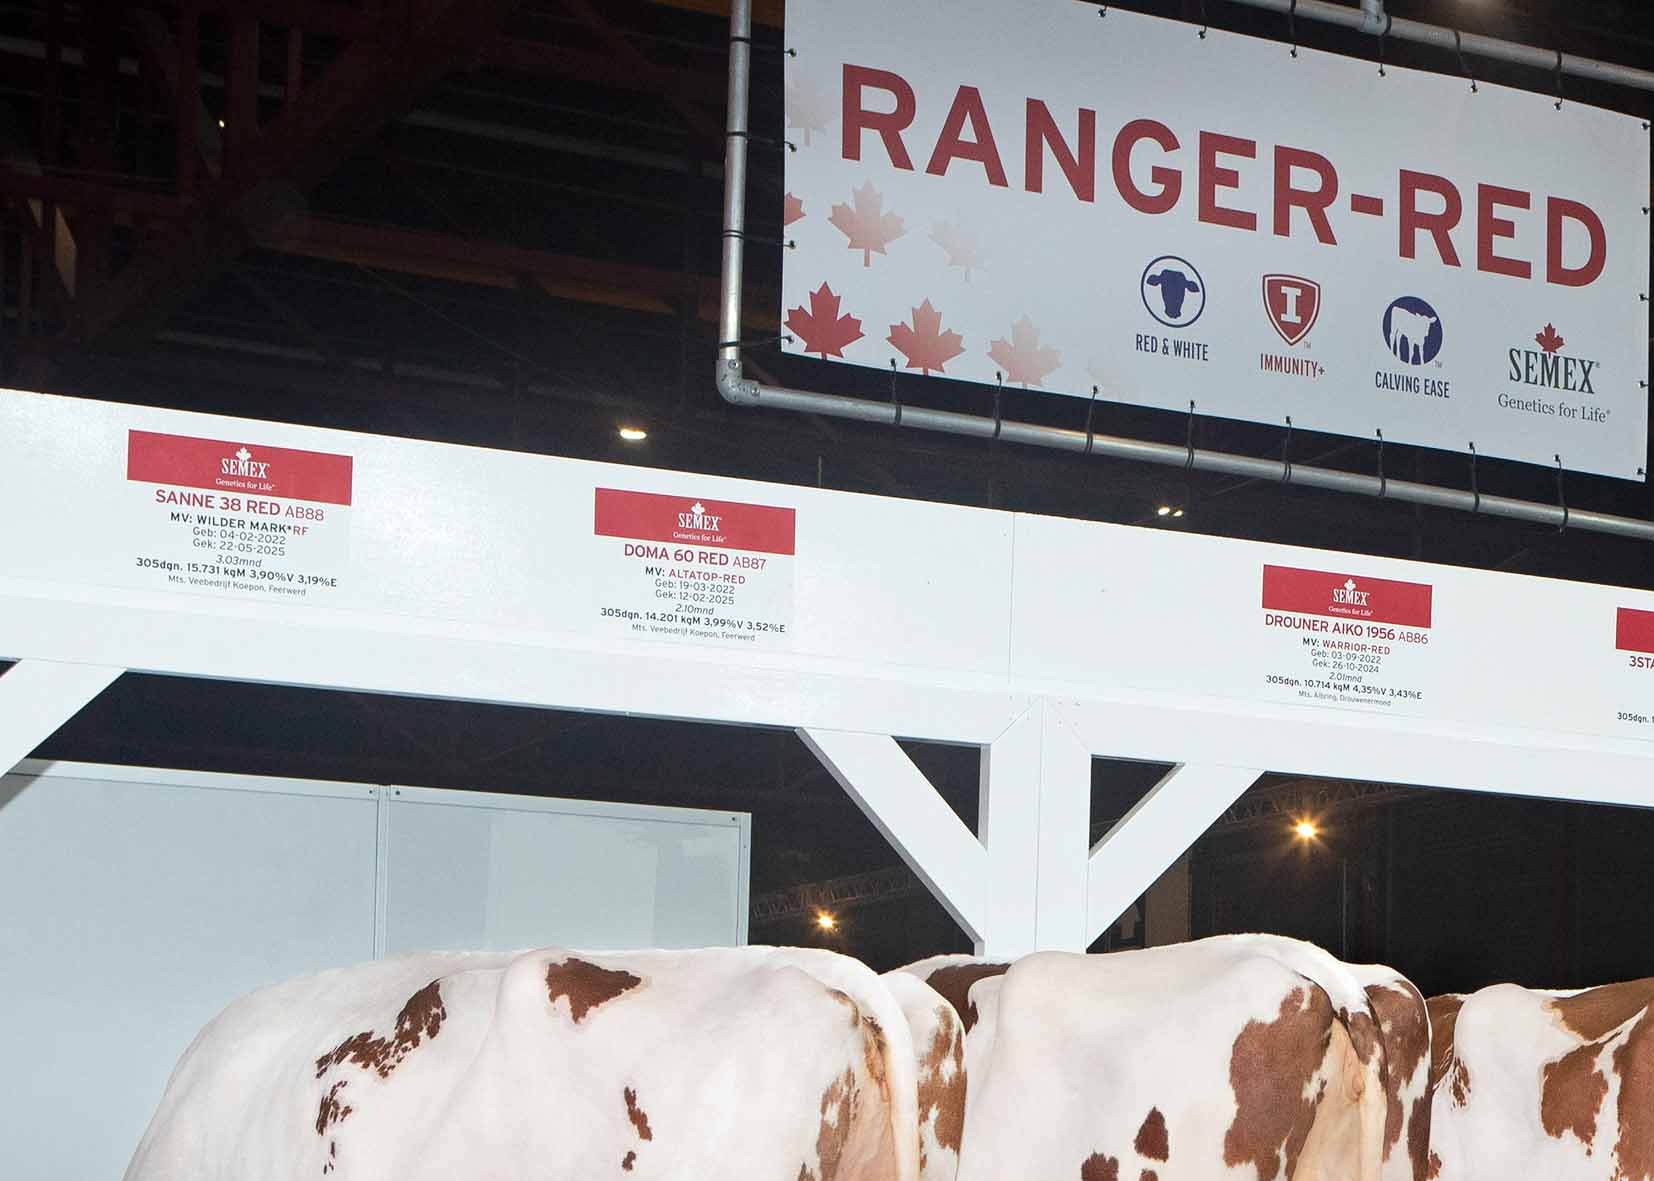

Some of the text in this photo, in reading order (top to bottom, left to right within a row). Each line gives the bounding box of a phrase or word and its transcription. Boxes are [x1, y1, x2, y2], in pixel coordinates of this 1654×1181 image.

[842, 64, 1608, 287] RANGER-RED
[1280, 286, 1301, 324] I
[1136, 334, 1208, 361] RED & WHITE
[1261, 353, 1325, 378] IMMUNITY+
[1509, 348, 1595, 394] SEMEX
[1375, 371, 1449, 398] CALVING EASE
[1498, 393, 1606, 423] Genetics for Life
[222, 459, 267, 479] SEMEX
[156, 489, 324, 521] SANNE 38 RED AB88
[171, 513, 192, 523] MV:
[197, 515, 245, 529] WILDER
[678, 513, 719, 531] SEMEX
[193, 527, 286, 544] Geb: 04-02-2022
[193, 539, 285, 556] Gek: 22-05-2025
[624, 544, 766, 570] DOMA 60 RED AB87
[136, 558, 336, 587] 305dgn. 15.731 kgM 3,90%V 3,19%E
[645, 567, 745, 584] MV: ALTATOP-RED
[655, 579, 735, 594] Geb: 19-03-2022
[655, 590, 734, 605] Gek: 12-02-2025
[1333, 589, 1368, 606] SEMEX
[601, 608, 785, 633] 305dgn. 14.201 kgM 3,99%V 3,52%E
[1265, 614, 1428, 644] DROUNER AIKO 1956 AB86
[1303, 638, 1390, 655] MV: WARRIOR-RED
[1311, 650, 1381, 664] Geb: 03-09-2022
[1313, 659, 1379, 673] Gek: 26-10-2024
